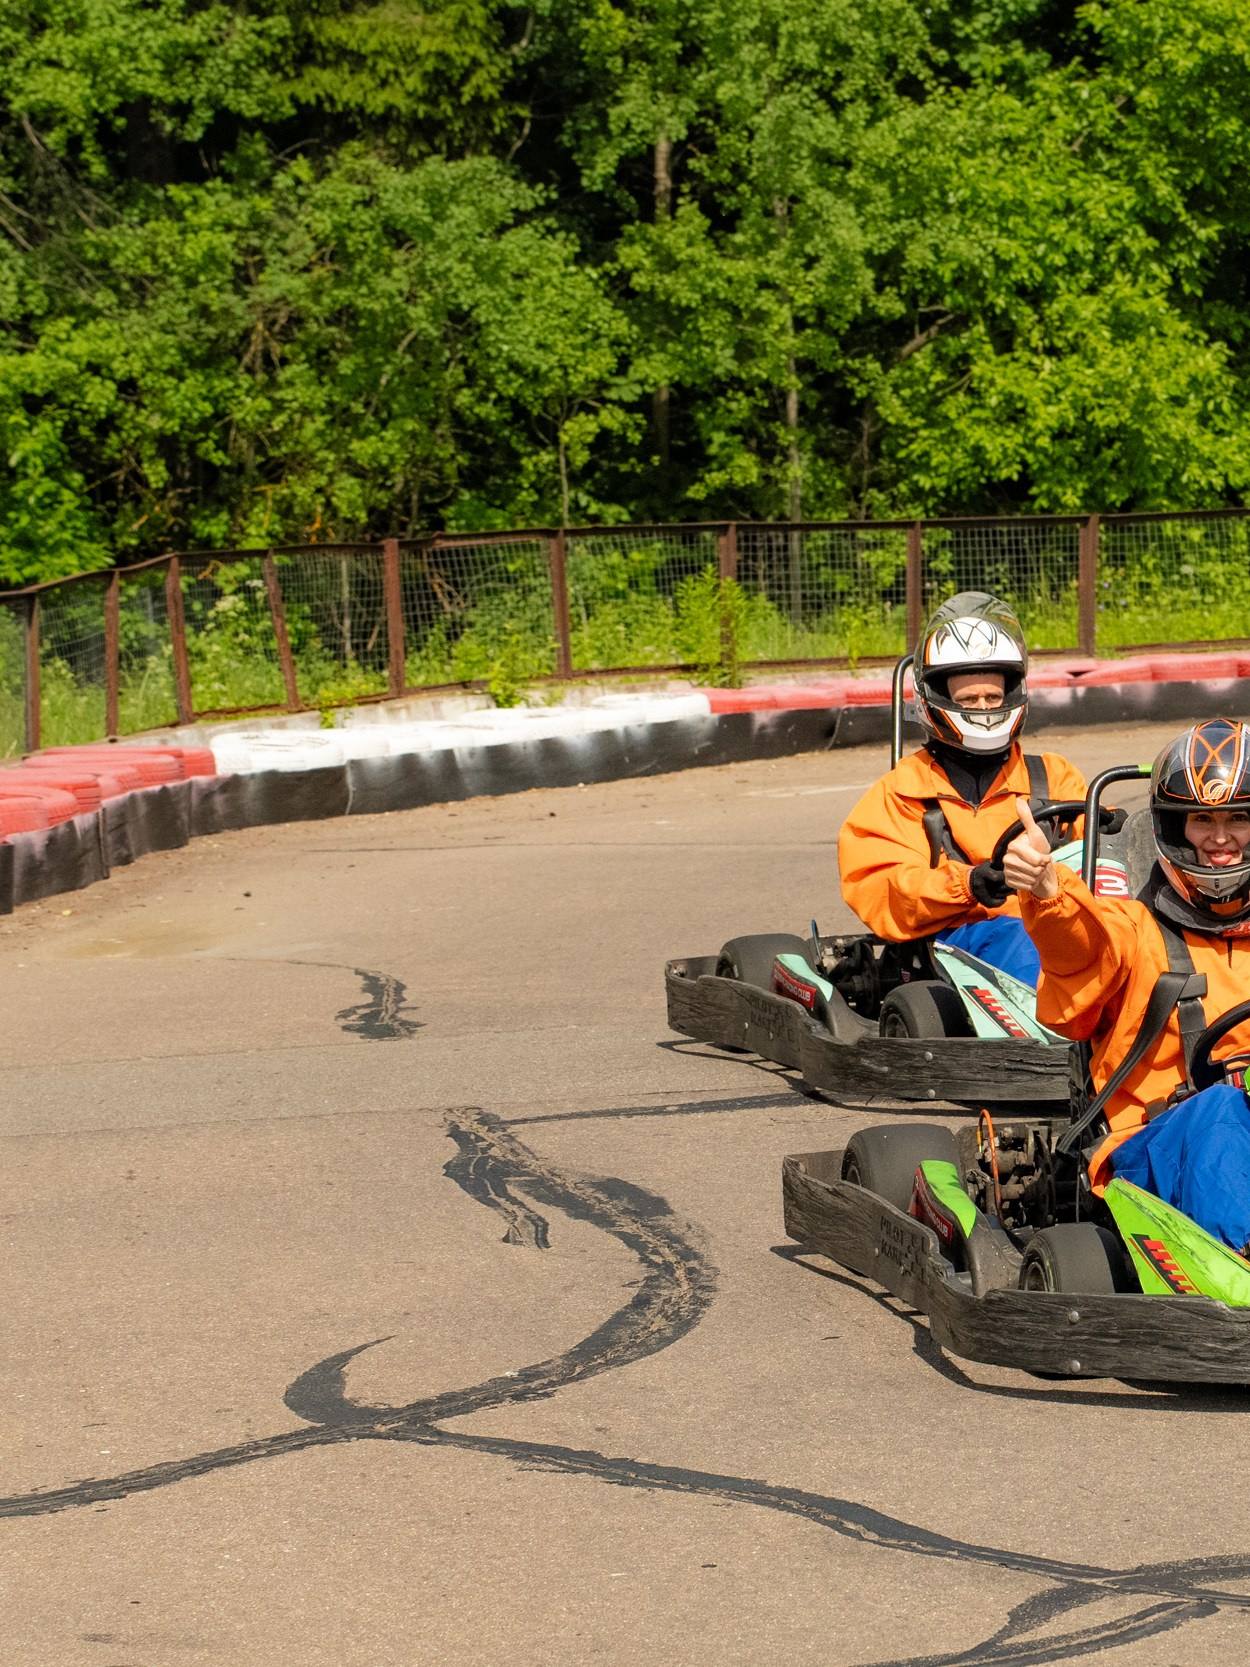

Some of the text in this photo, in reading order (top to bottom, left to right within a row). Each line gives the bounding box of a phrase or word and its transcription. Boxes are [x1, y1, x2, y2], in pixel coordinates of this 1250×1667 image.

[1095, 874, 1129, 896] 3
[798, 987, 811, 1002] CLUB
[880, 1216, 903, 1246] PILOT
[936, 1217, 949, 1238] CLUB
